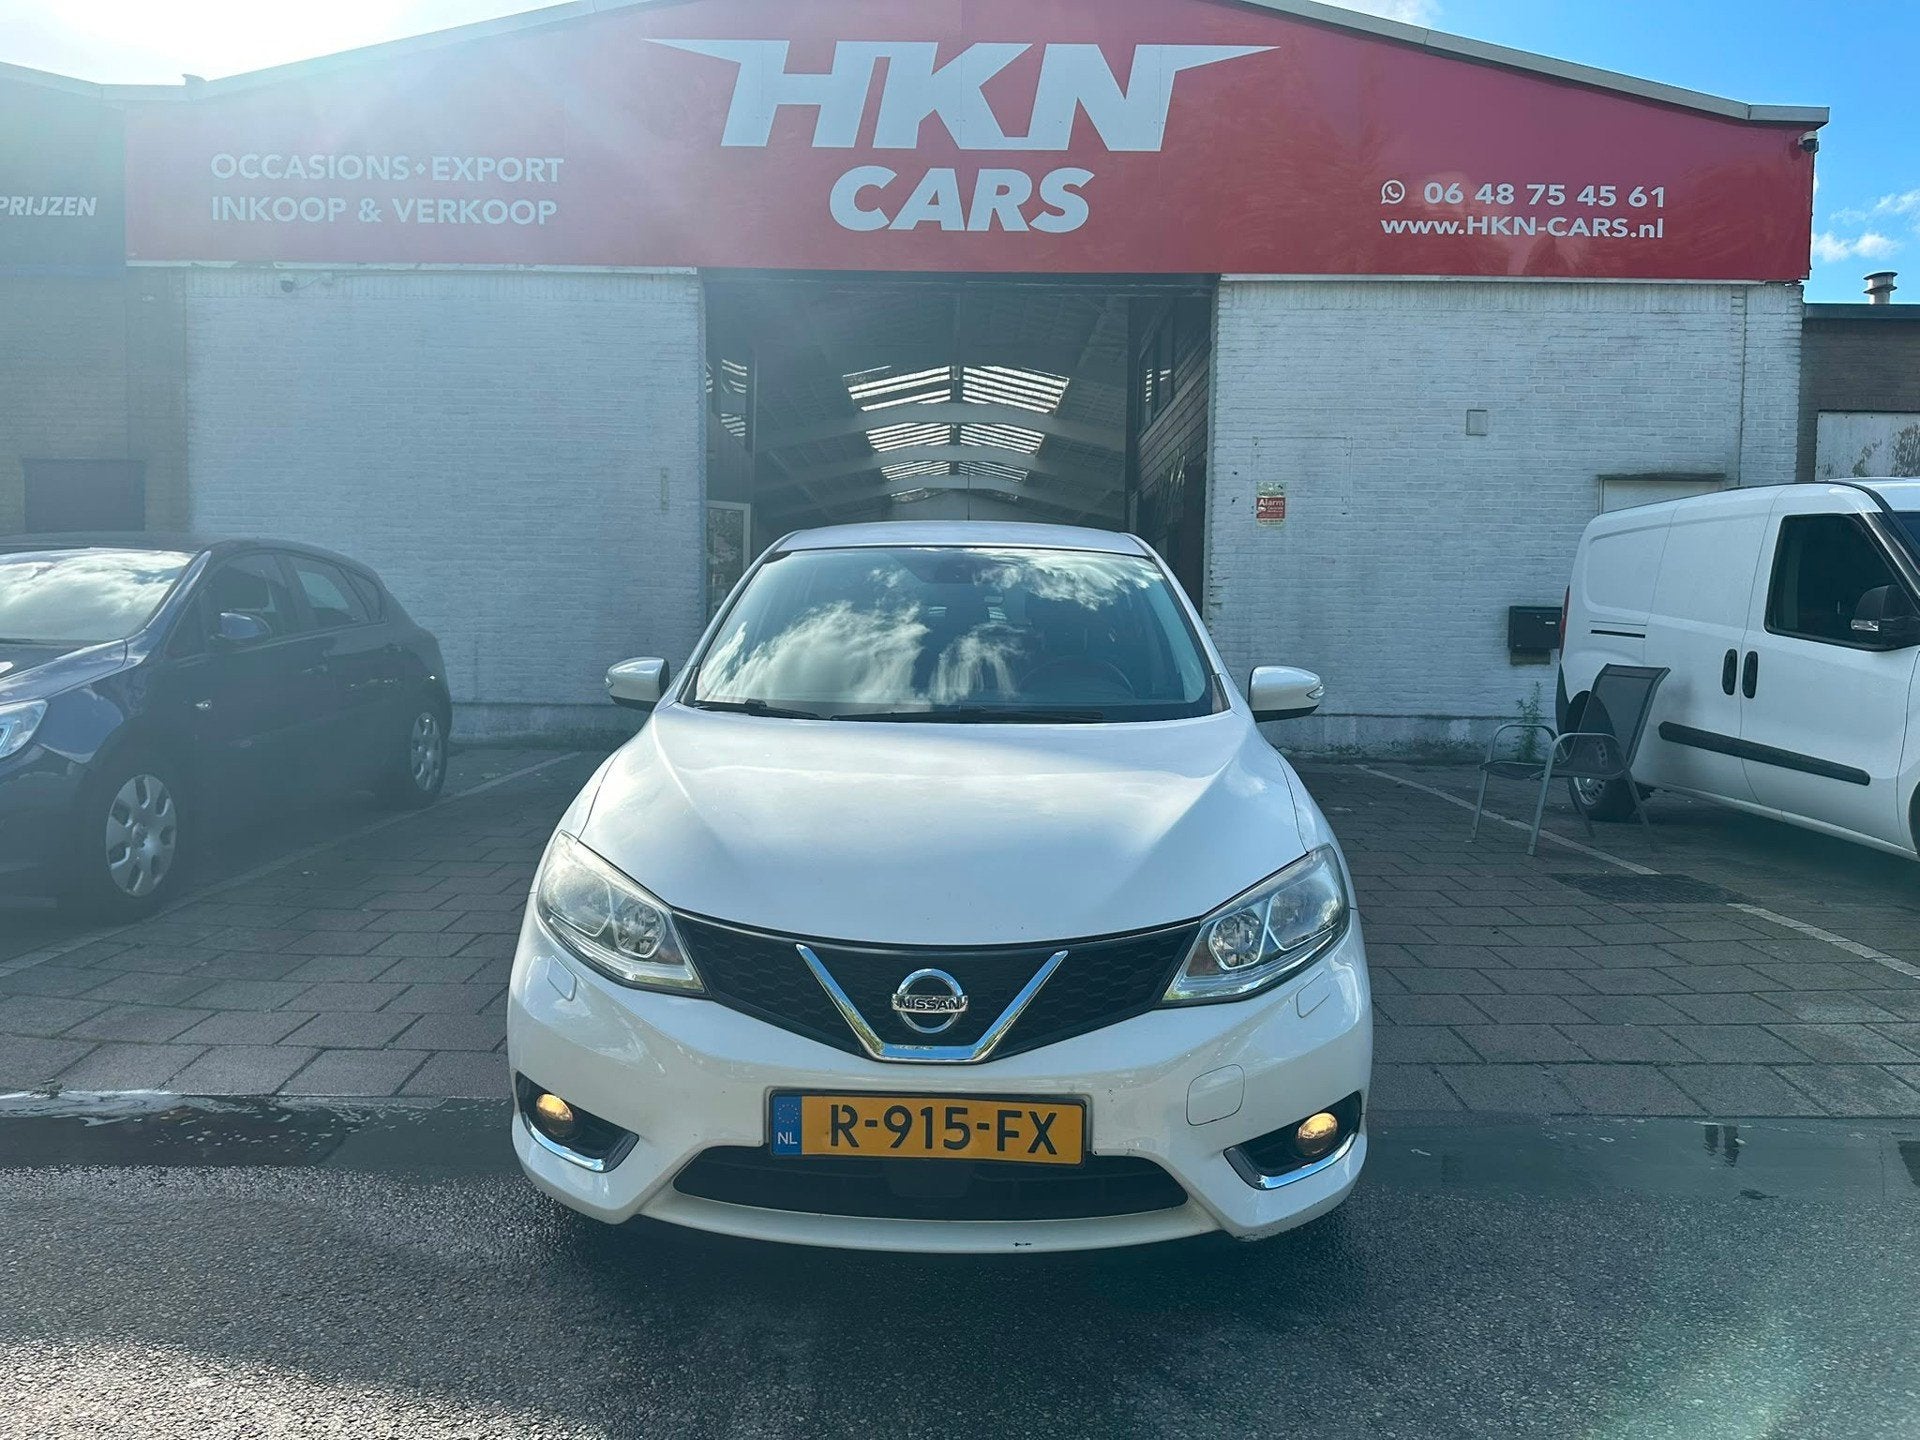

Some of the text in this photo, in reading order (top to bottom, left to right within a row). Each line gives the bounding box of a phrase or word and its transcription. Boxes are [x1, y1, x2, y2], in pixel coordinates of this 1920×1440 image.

[642, 38, 1281, 152] HKN
[210, 153, 564, 183] OCCASIONS EXPORT
[829, 165, 1095, 234] CARS
[1423, 182, 1665, 208] 06 48 75 45 61
[211, 196, 557, 226] INKOOP & VERKOOP
[1380, 215, 1664, 238] www.HKN-CARS.nl
[897, 998, 960, 1010] NISSAN
[777, 1131, 797, 1145] NL
[830, 1104, 1057, 1155] R-915-FX
